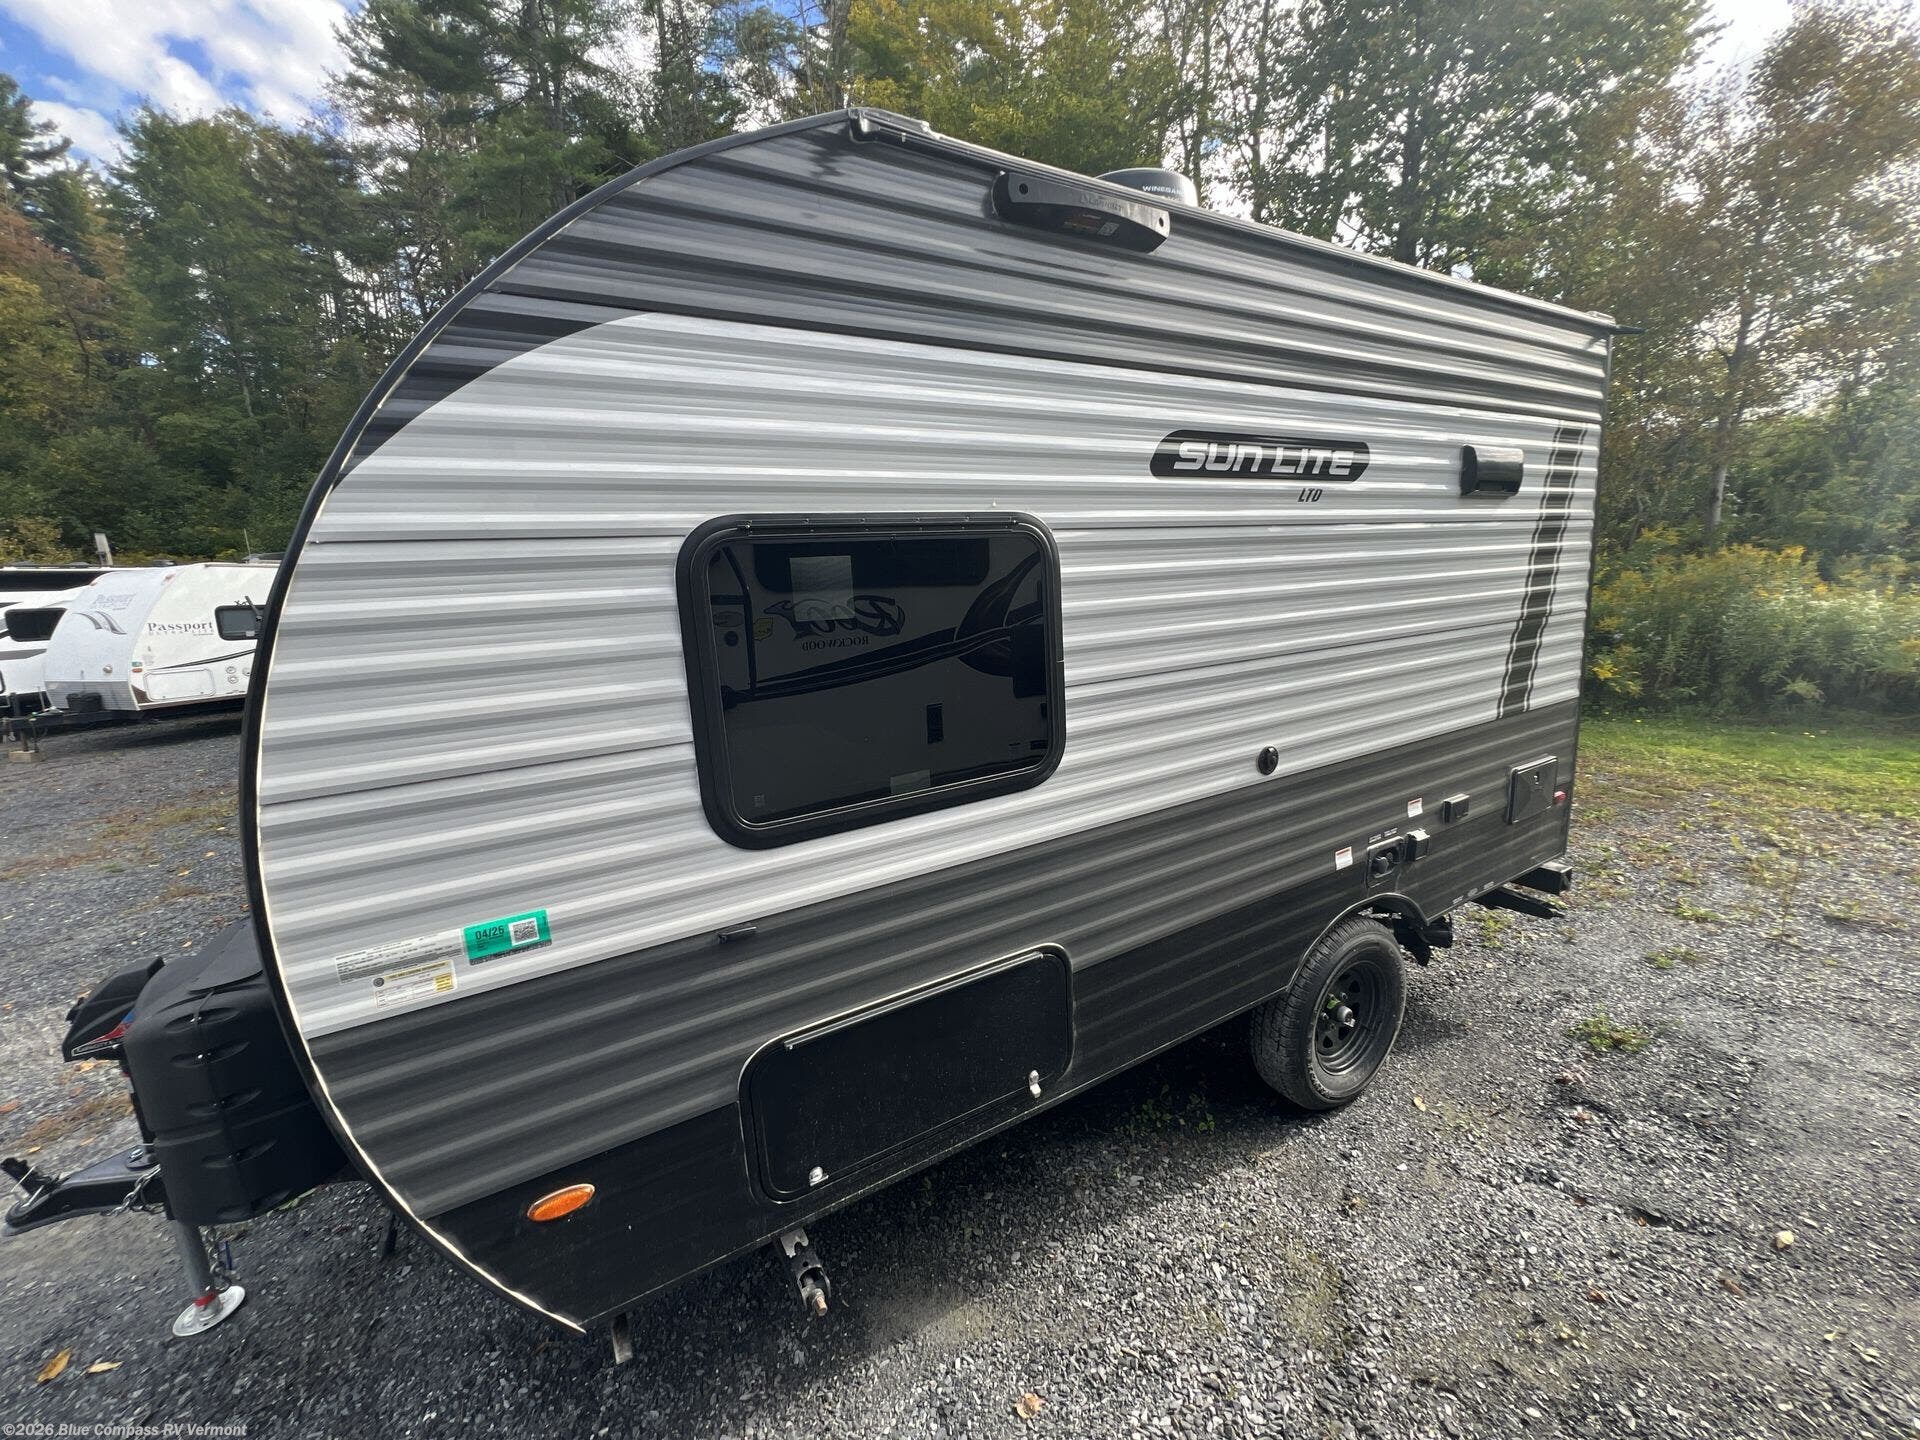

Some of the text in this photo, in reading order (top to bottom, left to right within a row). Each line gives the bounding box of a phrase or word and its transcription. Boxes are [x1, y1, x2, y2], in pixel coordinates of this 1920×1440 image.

[1173, 441, 1356, 476] SUN LITE
[1297, 488, 1324, 503] LTD
[147, 621, 213, 632] Passport
[475, 925, 505, 941] 04/26
